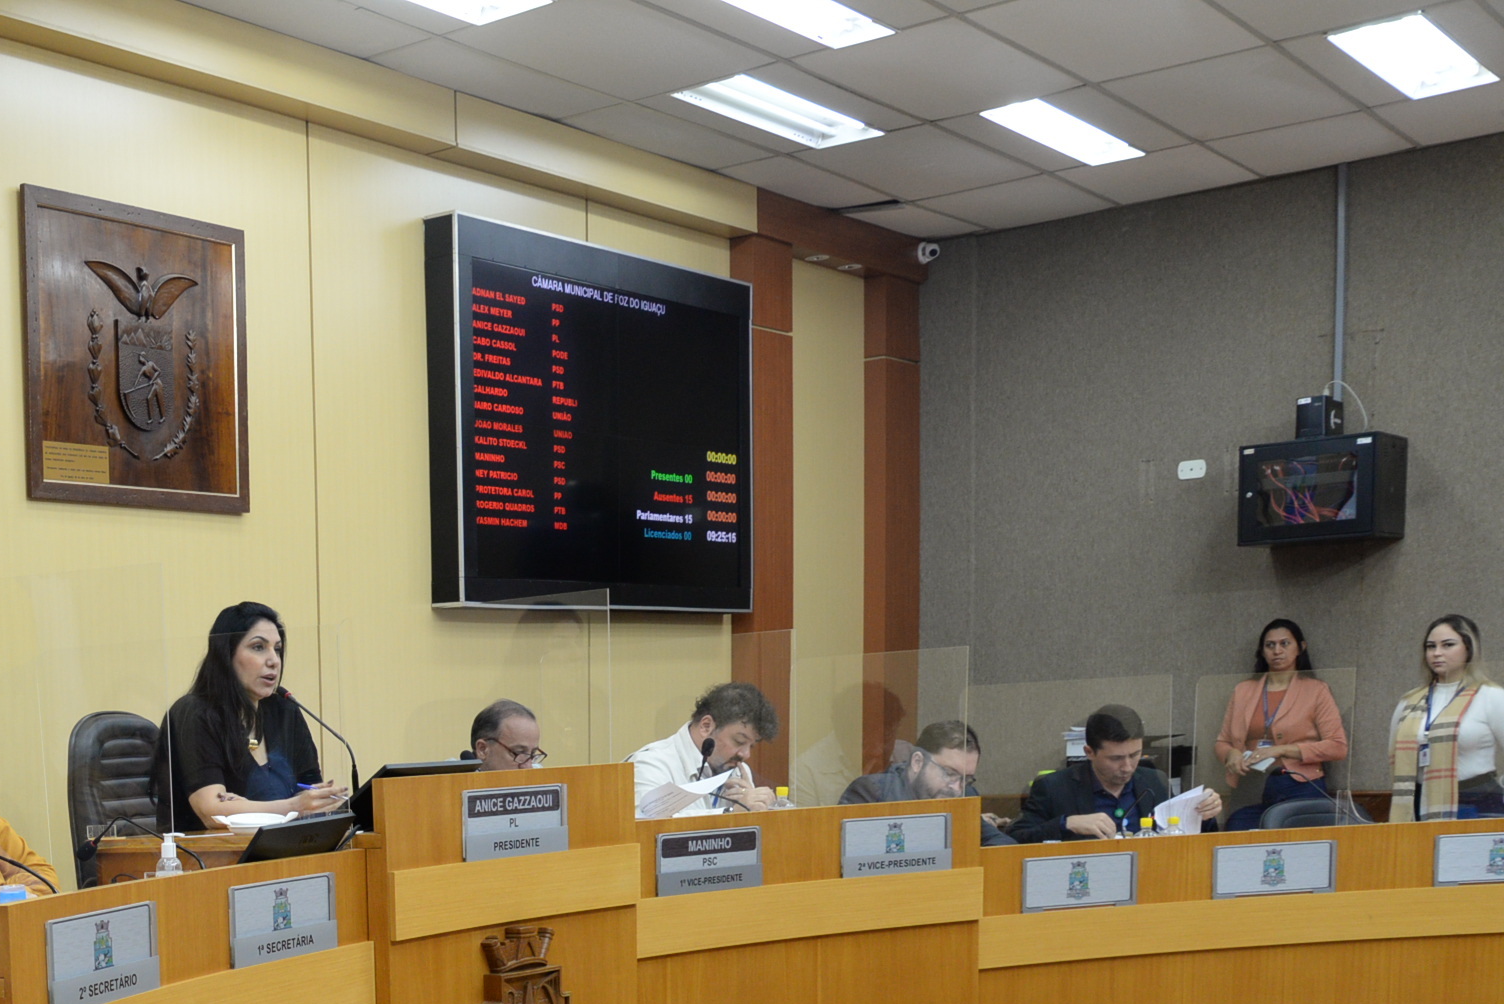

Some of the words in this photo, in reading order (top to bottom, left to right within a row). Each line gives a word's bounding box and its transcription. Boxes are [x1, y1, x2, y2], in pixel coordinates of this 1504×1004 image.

[472, 287, 495, 299] ADNAN
[496, 291, 504, 301] EL
[505, 293, 526, 305] SAYED
[531, 275, 563, 293] CÂMARA
[564, 282, 602, 302] MUNICIPAL
[603, 291, 614, 304] DE
[629, 297, 640, 310] DO
[640, 299, 666, 316] IGUAÇU
[472, 303, 489, 314] ALEX
[490, 307, 512, 318] MEYER
[551, 303, 565, 313] PSD
[472, 320, 492, 331] ANICE
[493, 323, 526, 336] GAZZAOUI
[551, 318, 560, 327] PP
[472, 336, 490, 346] CABO
[491, 339, 517, 351] CASSOL
[551, 334, 560, 343] PL
[485, 354, 511, 366] FREITAS
[552, 350, 569, 360] PODE
[552, 365, 564, 374] PSD
[473, 368, 505, 380] EDIVALDO
[505, 373, 543, 387] ALCANTARA
[552, 380, 564, 390] PTB
[493, 403, 524, 415] CARDOSO
[493, 422, 523, 433] MORALES
[475, 436, 498, 446] KALITO
[499, 438, 527, 449] STOECKL
[553, 445, 566, 454] PSD
[475, 452, 505, 463] MANINHO
[706, 450, 737, 465] 00:00:00
[553, 460, 566, 469] PSC
[475, 469, 488, 478] NEY
[489, 470, 518, 481] PATRICIO
[553, 476, 566, 485] PSD
[651, 469, 683, 483] Presentes
[684, 474, 693, 484] 00
[706, 471, 736, 484] 00:00:00
[476, 485, 512, 496] PROTETORA
[513, 488, 535, 498] CAROL
[554, 492, 562, 500] PP
[653, 491, 683, 503] Ausentes
[685, 494, 693, 504] 15
[707, 490, 737, 504] 00:00:00
[505, 502, 535, 513] QUADROS
[554, 506, 566, 515] PTB
[501, 518, 528, 528] HACHEM
[636, 509, 683, 523] Parlamentares
[684, 514, 693, 524] 15
[707, 510, 737, 523] 00:00:00
[554, 521, 568, 530] MDB
[644, 527, 682, 540] Licenciados
[683, 531, 692, 541] 00
[706, 530, 736, 543] 09:25:15
[475, 797, 503, 813] ANICE
[506, 794, 553, 810] GAZZAOUI
[509, 818, 519, 828] PL
[493, 837, 540, 852] PRESIDENTE
[688, 837, 732, 852] MANINHO
[702, 856, 718, 867] PSC
[867, 857, 936, 870] VICE-PRESIDENTE
[687, 873, 743, 887] VICE-PRESIDENTE
[266, 934, 314, 954] SECRETÁRIA
[88, 973, 137, 997] SECRETÁRIO
